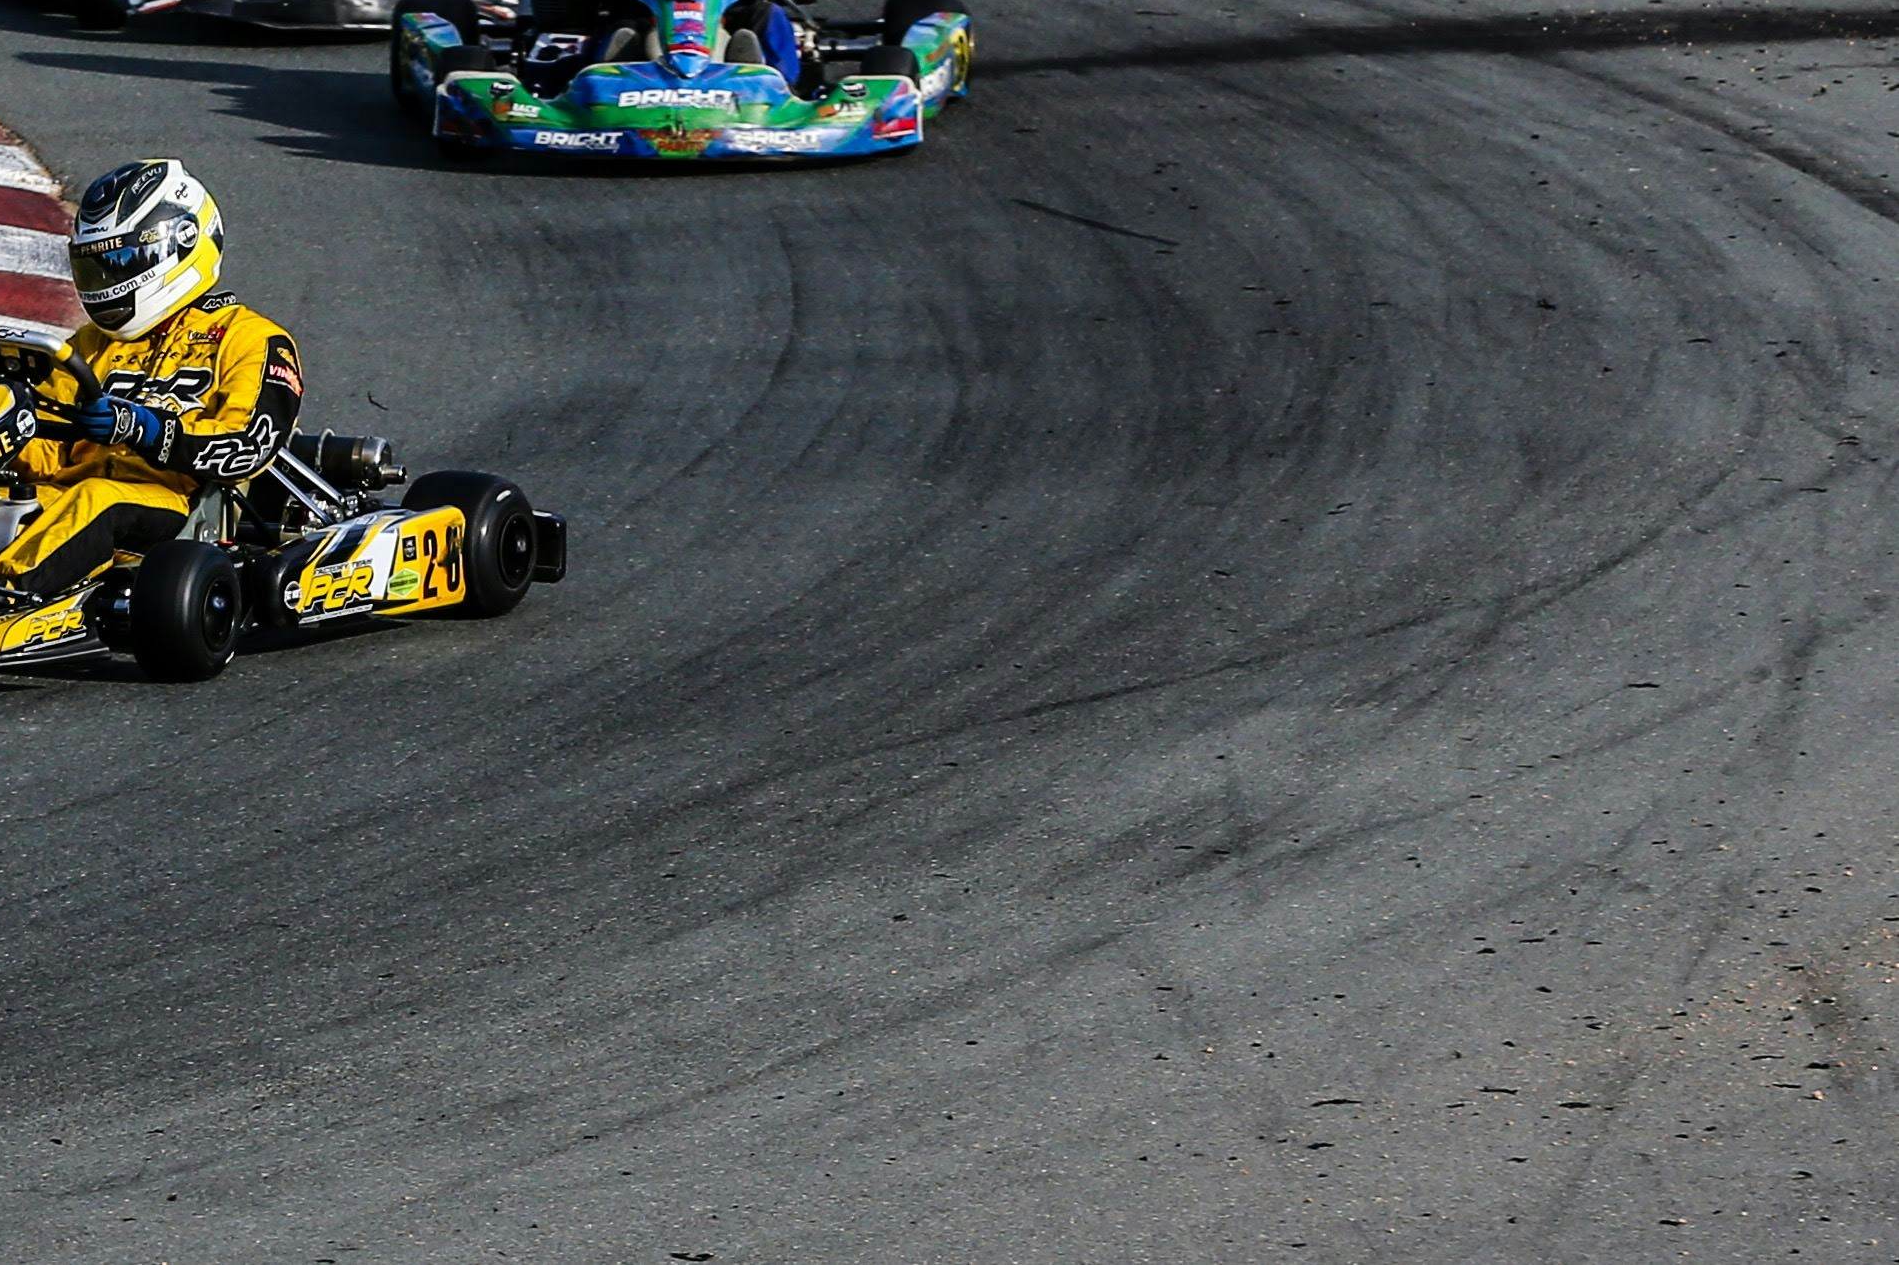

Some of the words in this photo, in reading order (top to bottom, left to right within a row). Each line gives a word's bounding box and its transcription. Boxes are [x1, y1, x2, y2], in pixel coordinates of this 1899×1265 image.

[618, 88, 733, 108] BRIGHT
[534, 131, 623, 146] BRIGHT
[131, 167, 162, 194] REEVU
[80, 237, 123, 255] PENRITE
[302, 565, 374, 612] PCR
[24, 611, 86, 644] PCR
